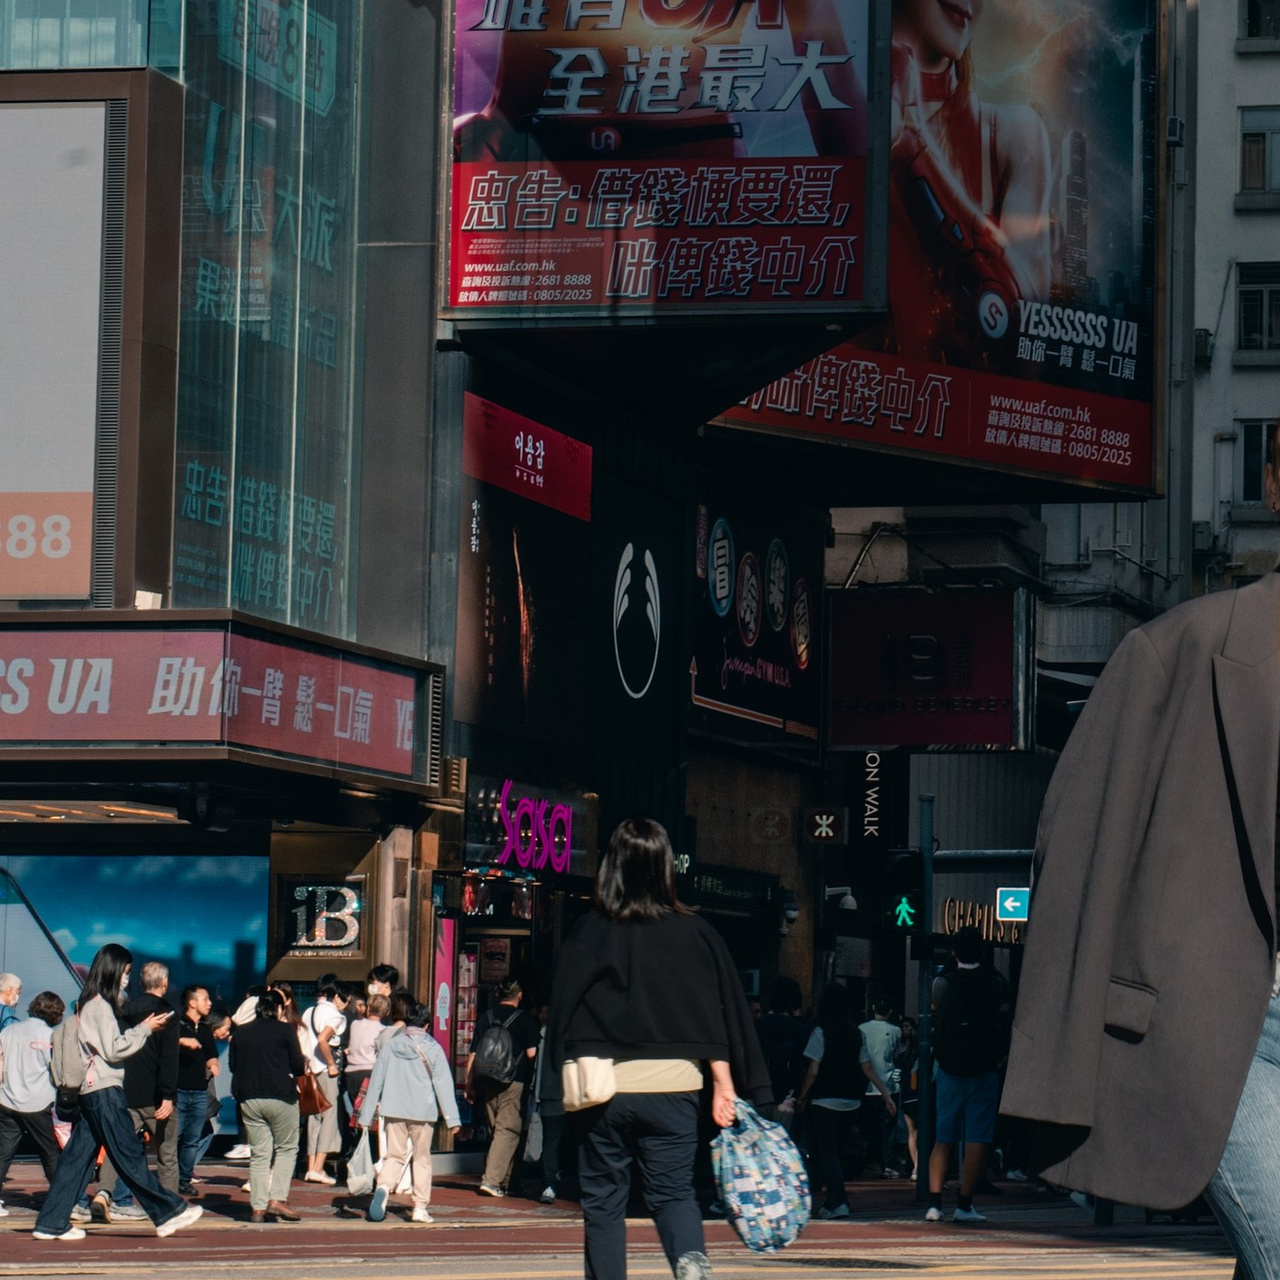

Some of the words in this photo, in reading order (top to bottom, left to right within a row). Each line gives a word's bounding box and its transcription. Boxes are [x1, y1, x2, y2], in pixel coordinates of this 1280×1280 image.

[525, 40, 856, 117] 全港最大
[464, 259, 556, 273] www.uaf.com.hk
[563, 274, 592, 286] 8888
[605, 234, 860, 299] 咪俾錢中介
[1112, 318, 1139, 356] UA
[1016, 336, 1074, 368] 助你一臂
[1080, 348, 1137, 381] 鬆一口氣
[989, 395, 1091, 423] www.uaf.com.hk
[1100, 428, 1130, 448] 8888
[47, 659, 113, 714] UA
[147, 657, 286, 727] 助你一臂
[294, 675, 373, 745] 鬆一口氣
[865, 751, 880, 781] ON
[864, 786, 879, 837] WALK
